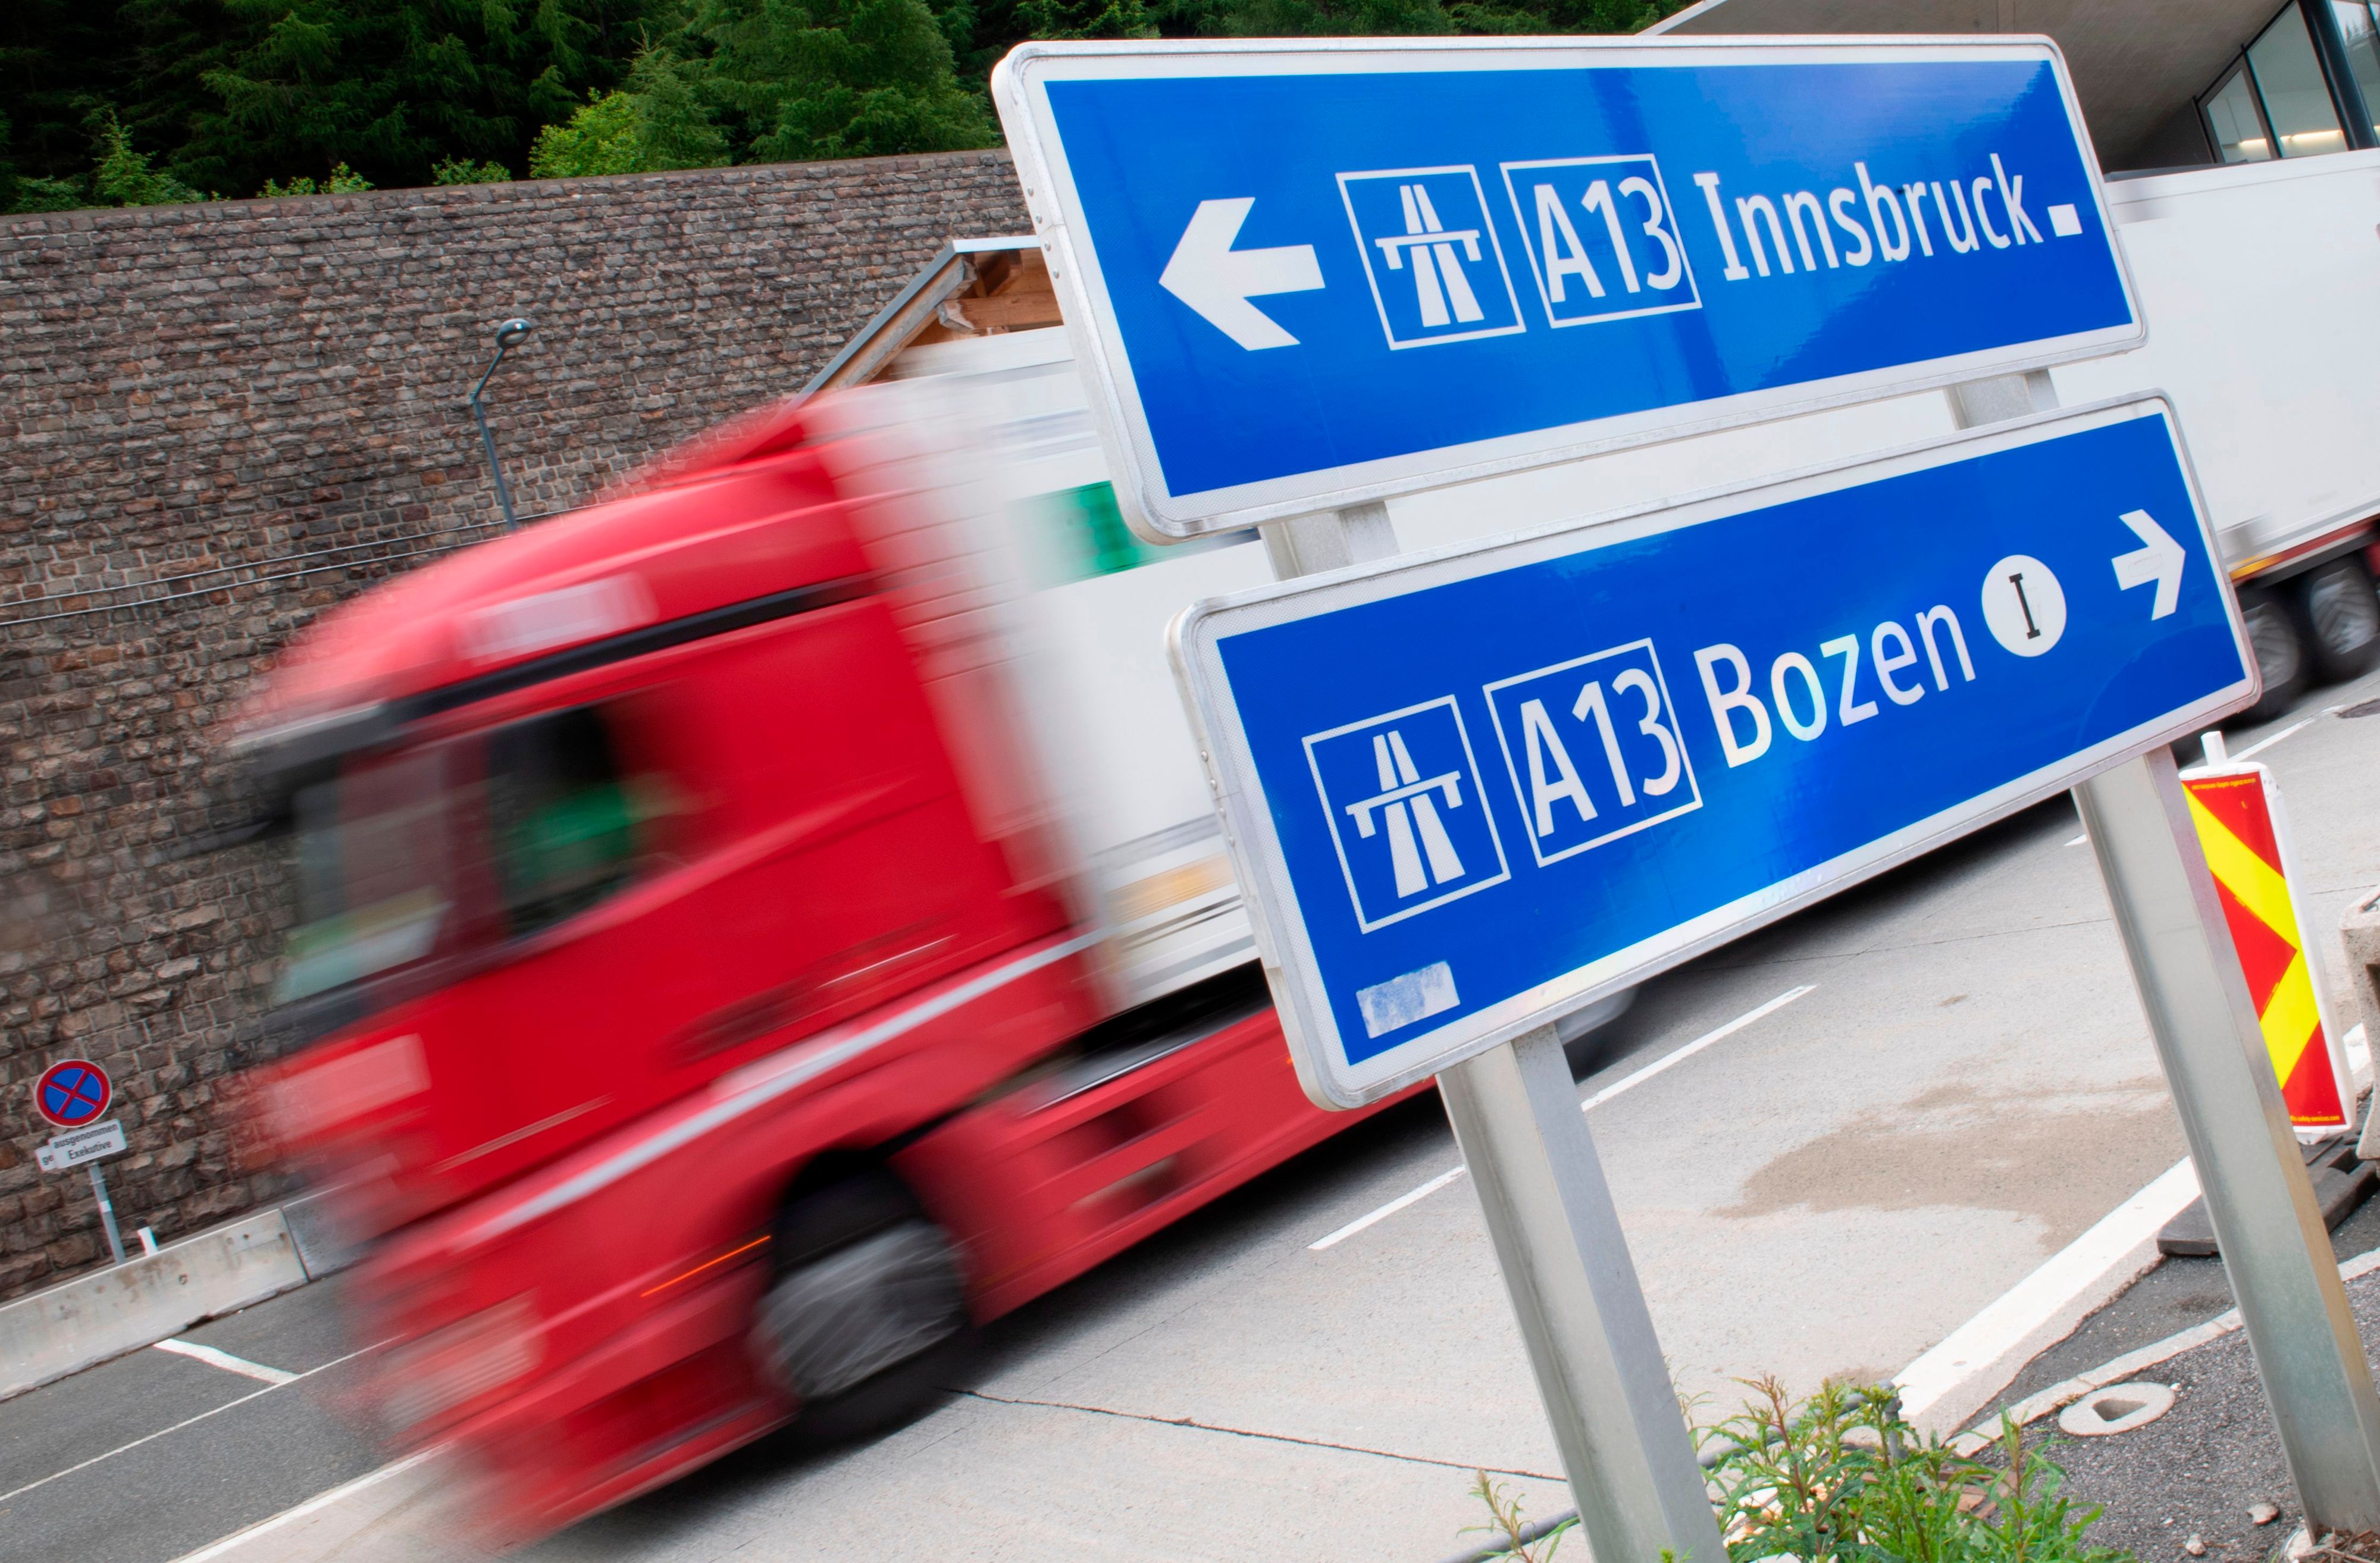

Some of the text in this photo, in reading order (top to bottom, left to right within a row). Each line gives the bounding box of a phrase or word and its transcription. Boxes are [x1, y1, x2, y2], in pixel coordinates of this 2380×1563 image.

[1534, 177, 1681, 302] A13
[1521, 669, 1681, 837] A13
[1693, 604, 1975, 768] Bozen
[54, 1124, 118, 1148] ausgenommen
[68, 1140, 112, 1160] Exekutive
